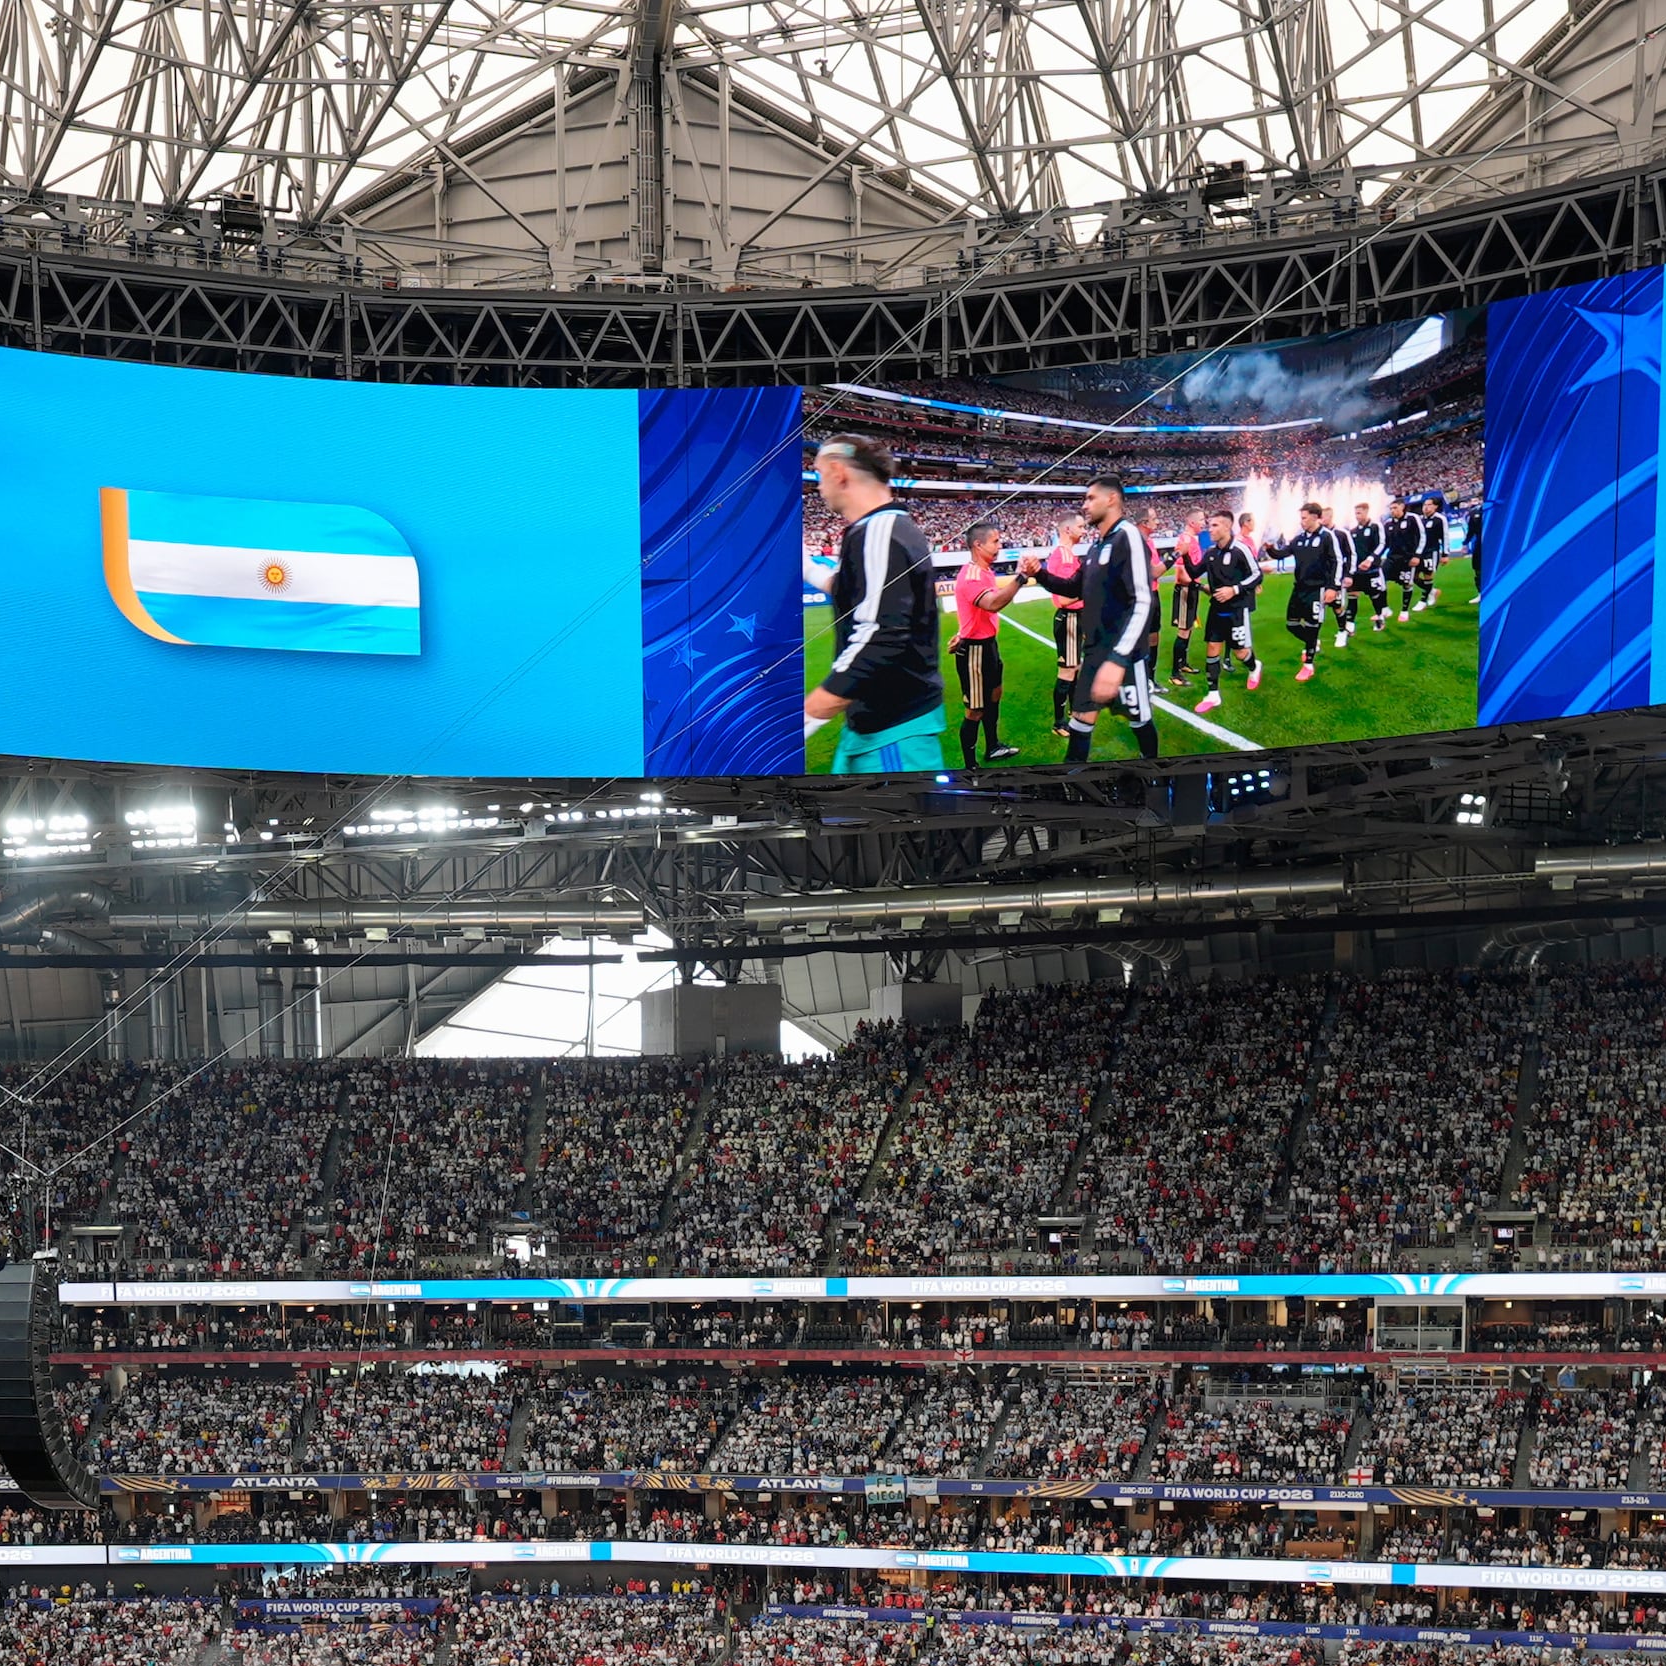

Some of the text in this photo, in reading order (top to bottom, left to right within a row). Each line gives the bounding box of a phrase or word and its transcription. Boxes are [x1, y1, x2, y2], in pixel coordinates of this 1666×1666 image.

[371, 1283, 422, 1296] ARGENTINA
[771, 1281, 821, 1293] ARGENTINA
[911, 1281, 1067, 1292] FIFA WORLD CUP 2026
[1185, 1279, 1239, 1291] ARGENTINA
[232, 1477, 319, 1487] ATLANTA
[546, 1475, 600, 1486] #FIFAWorldCup
[876, 1477, 893, 1487] FE
[1164, 1488, 1314, 1500] FIFA WORLD CUP 2026
[139, 1548, 192, 1560] ARGENTINA
[535, 1546, 587, 1558] ARGENTINA
[665, 1547, 814, 1562] FIFA WORLD CUP 2026
[916, 1554, 969, 1567] ARGENTINA
[1331, 1566, 1391, 1579] ARGENTINA
[1481, 1570, 1664, 1588] FIFA WORLD CUP 2026
[265, 1602, 403, 1613] FIFA WORLD CUP 2026
